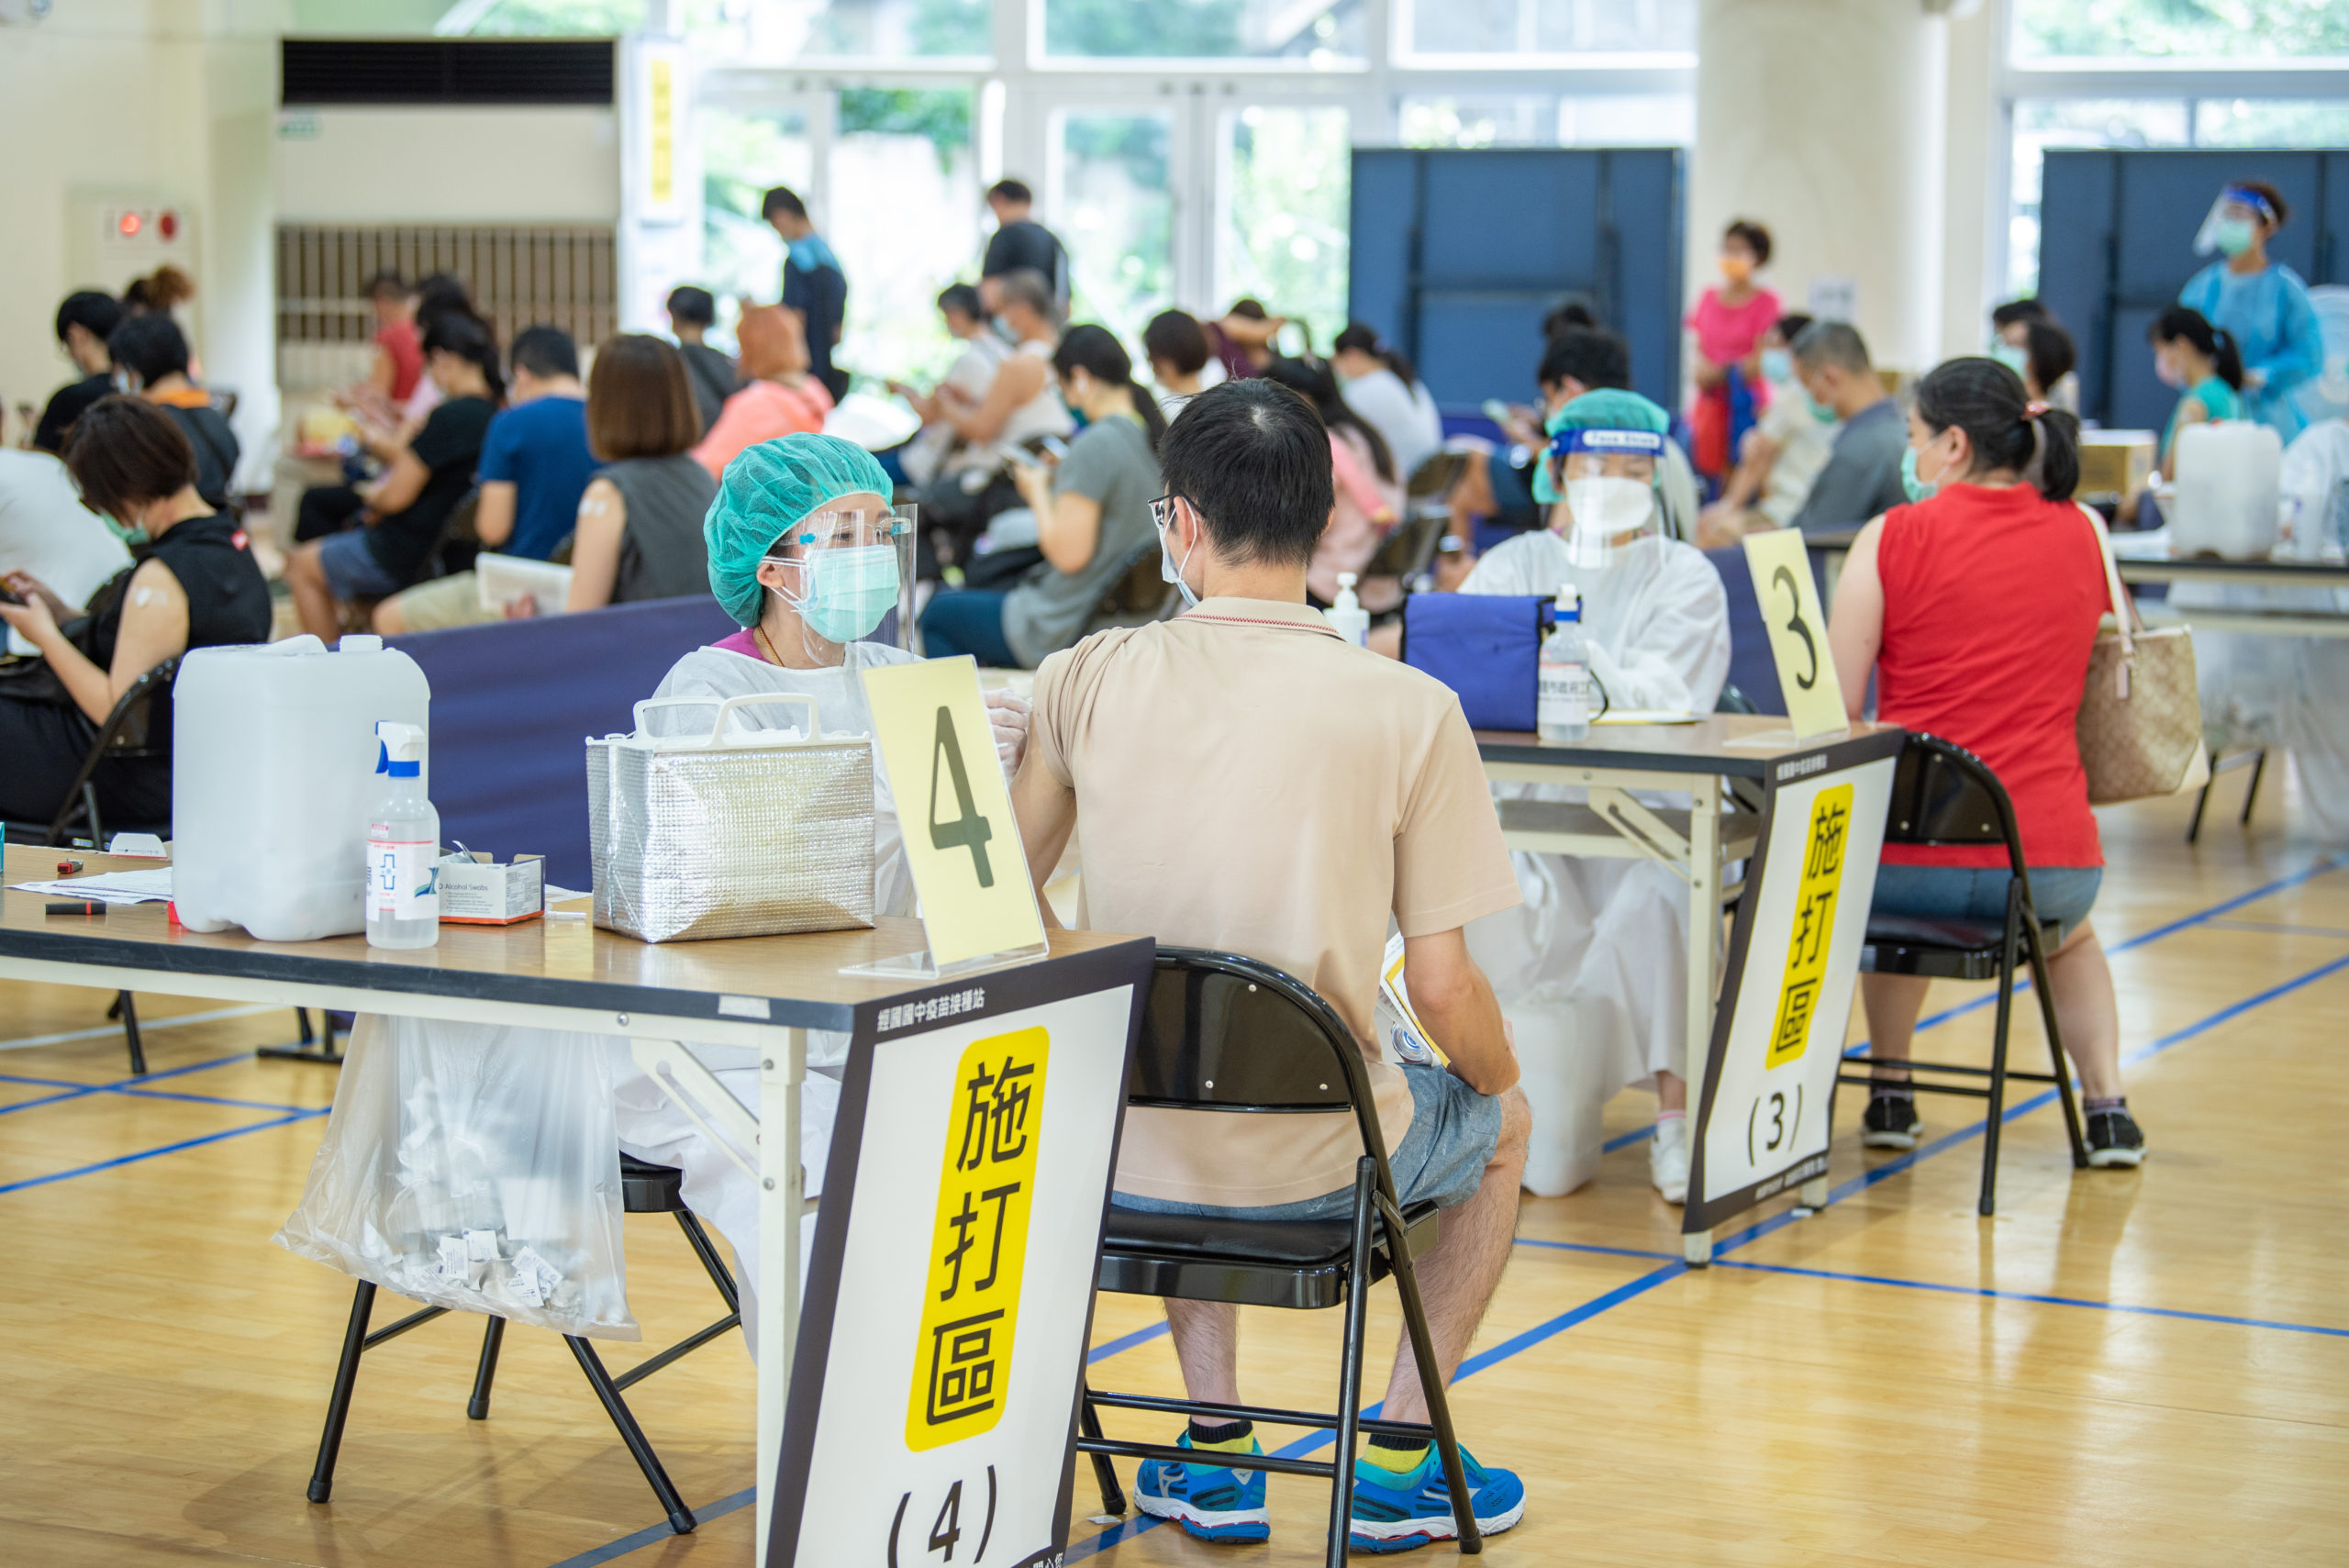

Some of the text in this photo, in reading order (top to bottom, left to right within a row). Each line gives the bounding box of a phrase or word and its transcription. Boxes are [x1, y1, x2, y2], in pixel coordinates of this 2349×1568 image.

[1773, 565, 1818, 690] 3
[930, 706, 994, 888] 4
[445, 883, 468, 891] Alcohol
[469, 884, 488, 892] Swabs
[1775, 803, 1846, 1054] 施打區
[1748, 1083, 1803, 1168] (3)
[926, 1055, 1036, 1426] 施打區
